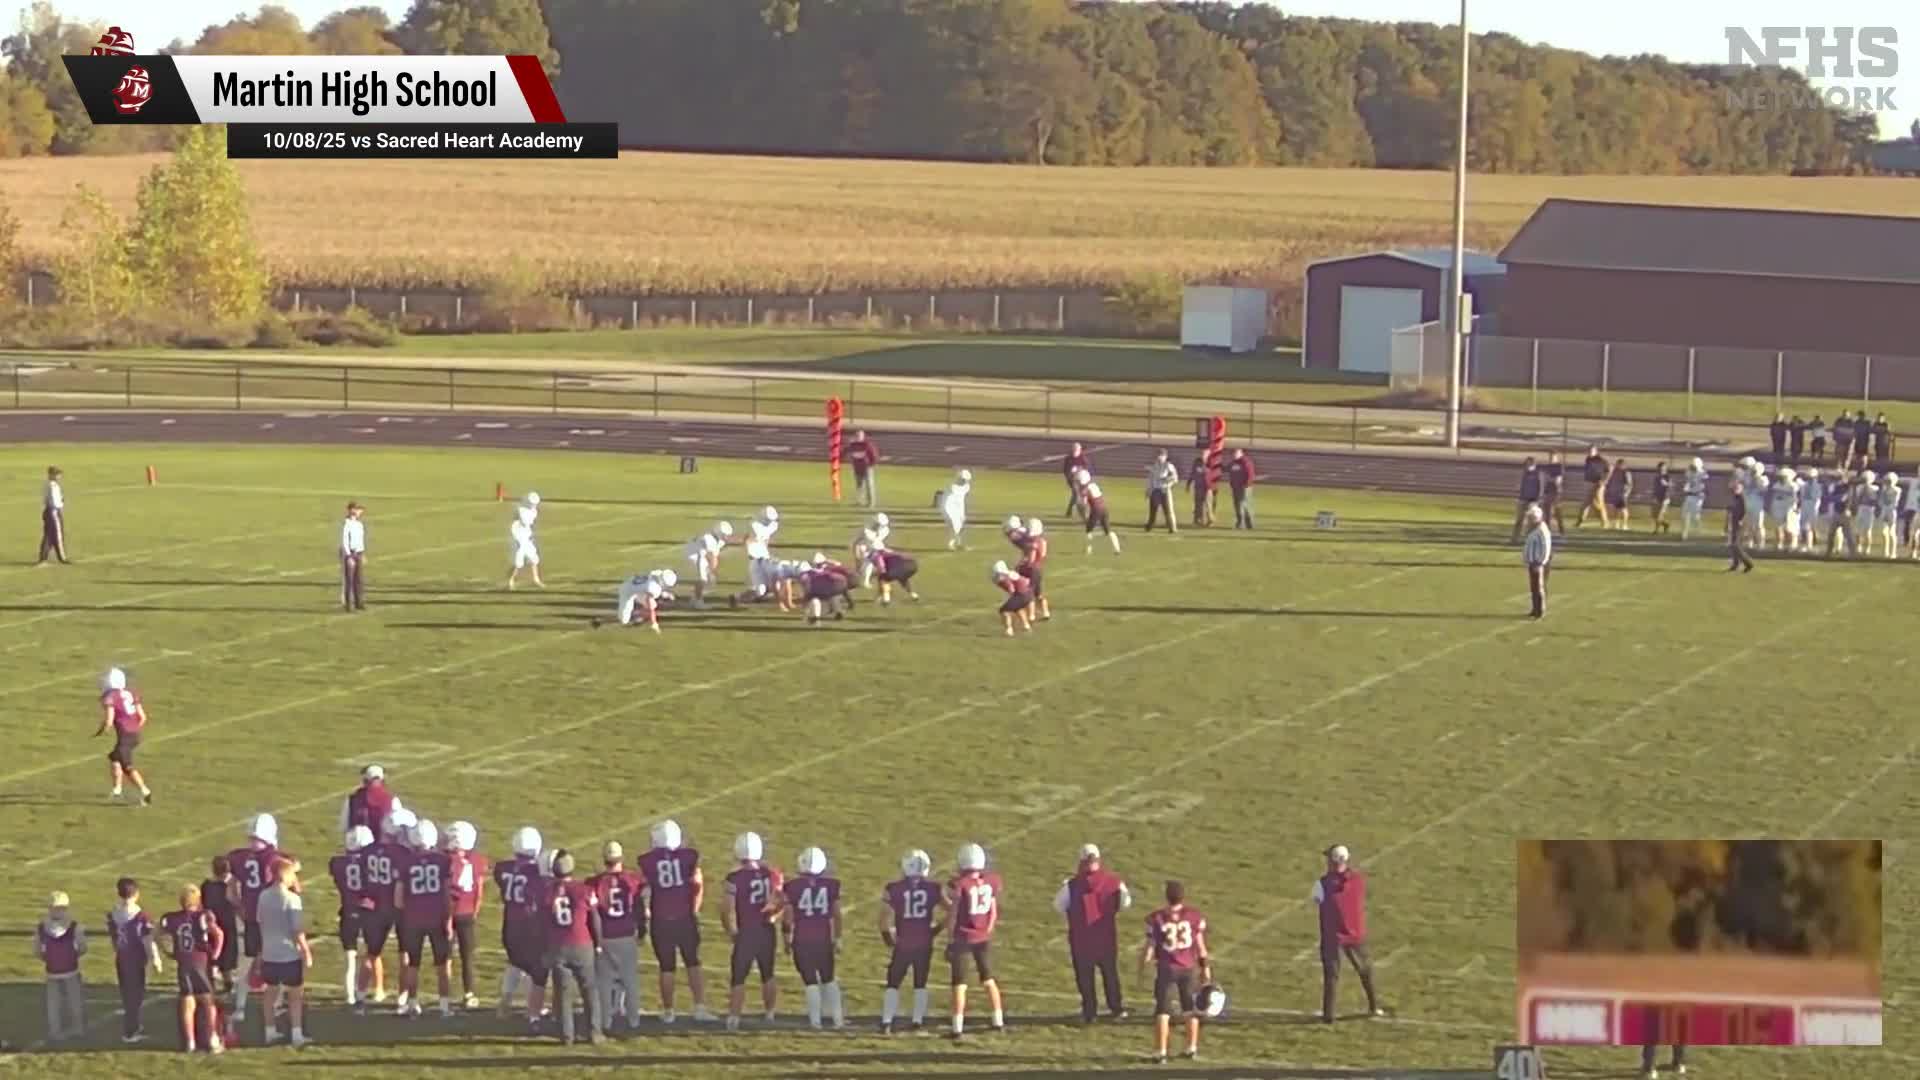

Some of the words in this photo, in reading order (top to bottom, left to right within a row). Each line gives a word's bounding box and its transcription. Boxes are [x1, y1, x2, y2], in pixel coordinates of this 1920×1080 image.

[245, 860, 260, 888] 3
[345, 864, 361, 891] 8
[367, 856, 392, 884] 99
[409, 864, 440, 895] 28
[457, 863, 474, 892] 4
[656, 859, 684, 889] 81
[501, 873, 528, 902] 72
[749, 879, 771, 905] 21
[798, 887, 830, 916] 44
[968, 884, 993, 915] 13
[554, 896, 573, 926] 6
[608, 888, 625, 917] 5
[903, 889, 928, 918] 12
[1160, 920, 1194, 952] 33
[1497, 1049, 1534, 1080] 40
